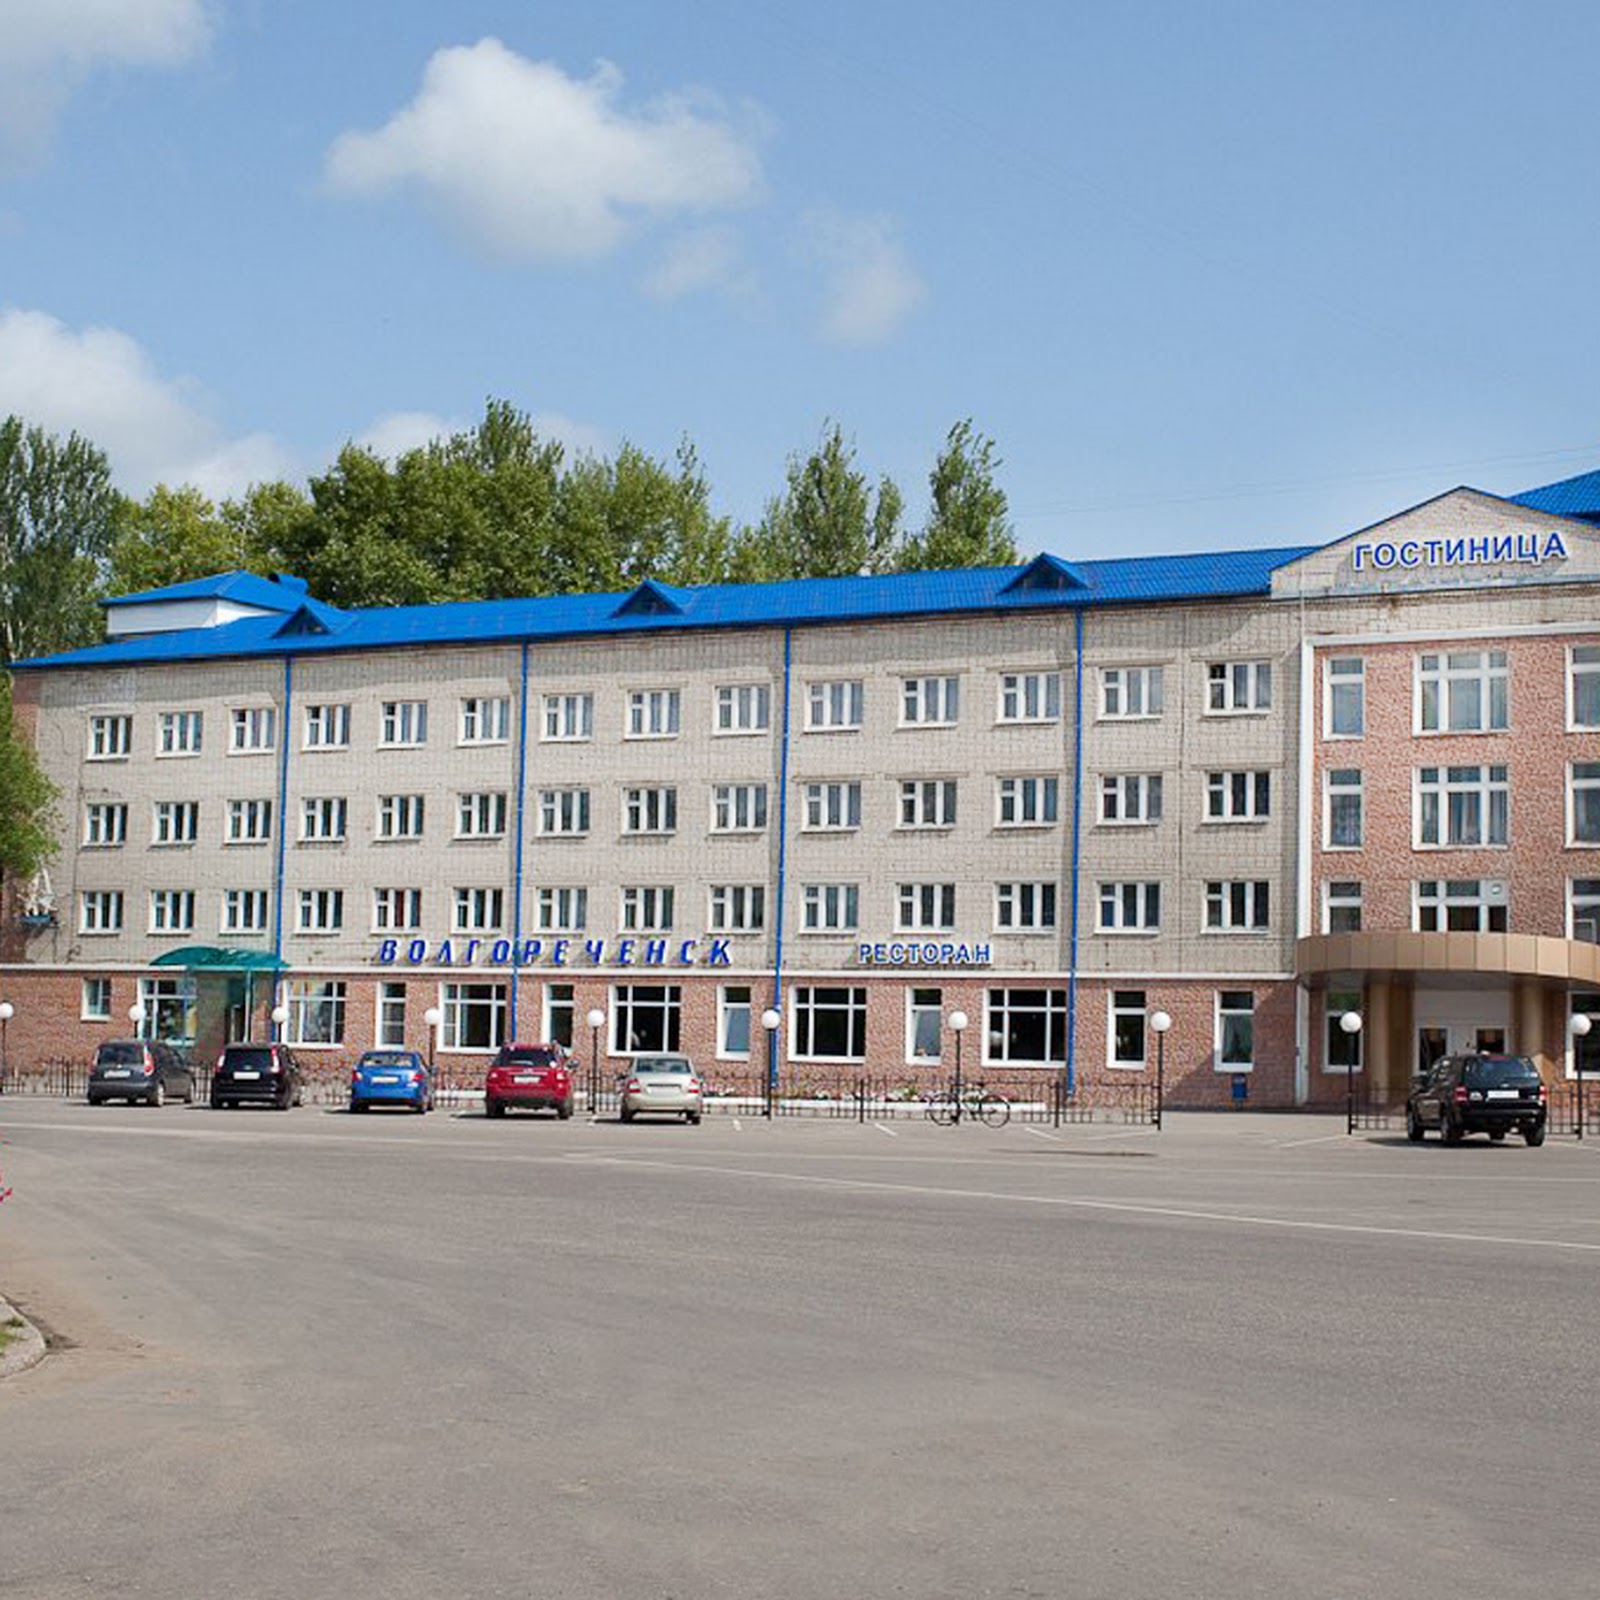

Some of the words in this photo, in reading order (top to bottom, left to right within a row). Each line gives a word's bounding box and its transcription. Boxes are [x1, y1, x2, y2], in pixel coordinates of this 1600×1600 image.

[1354, 531, 1567, 570] ГОСТИНИЦА
[379, 938, 734, 966] ВОЛГОРЕЧЕНСК
[858, 943, 992, 964] РЕСТОРАН
